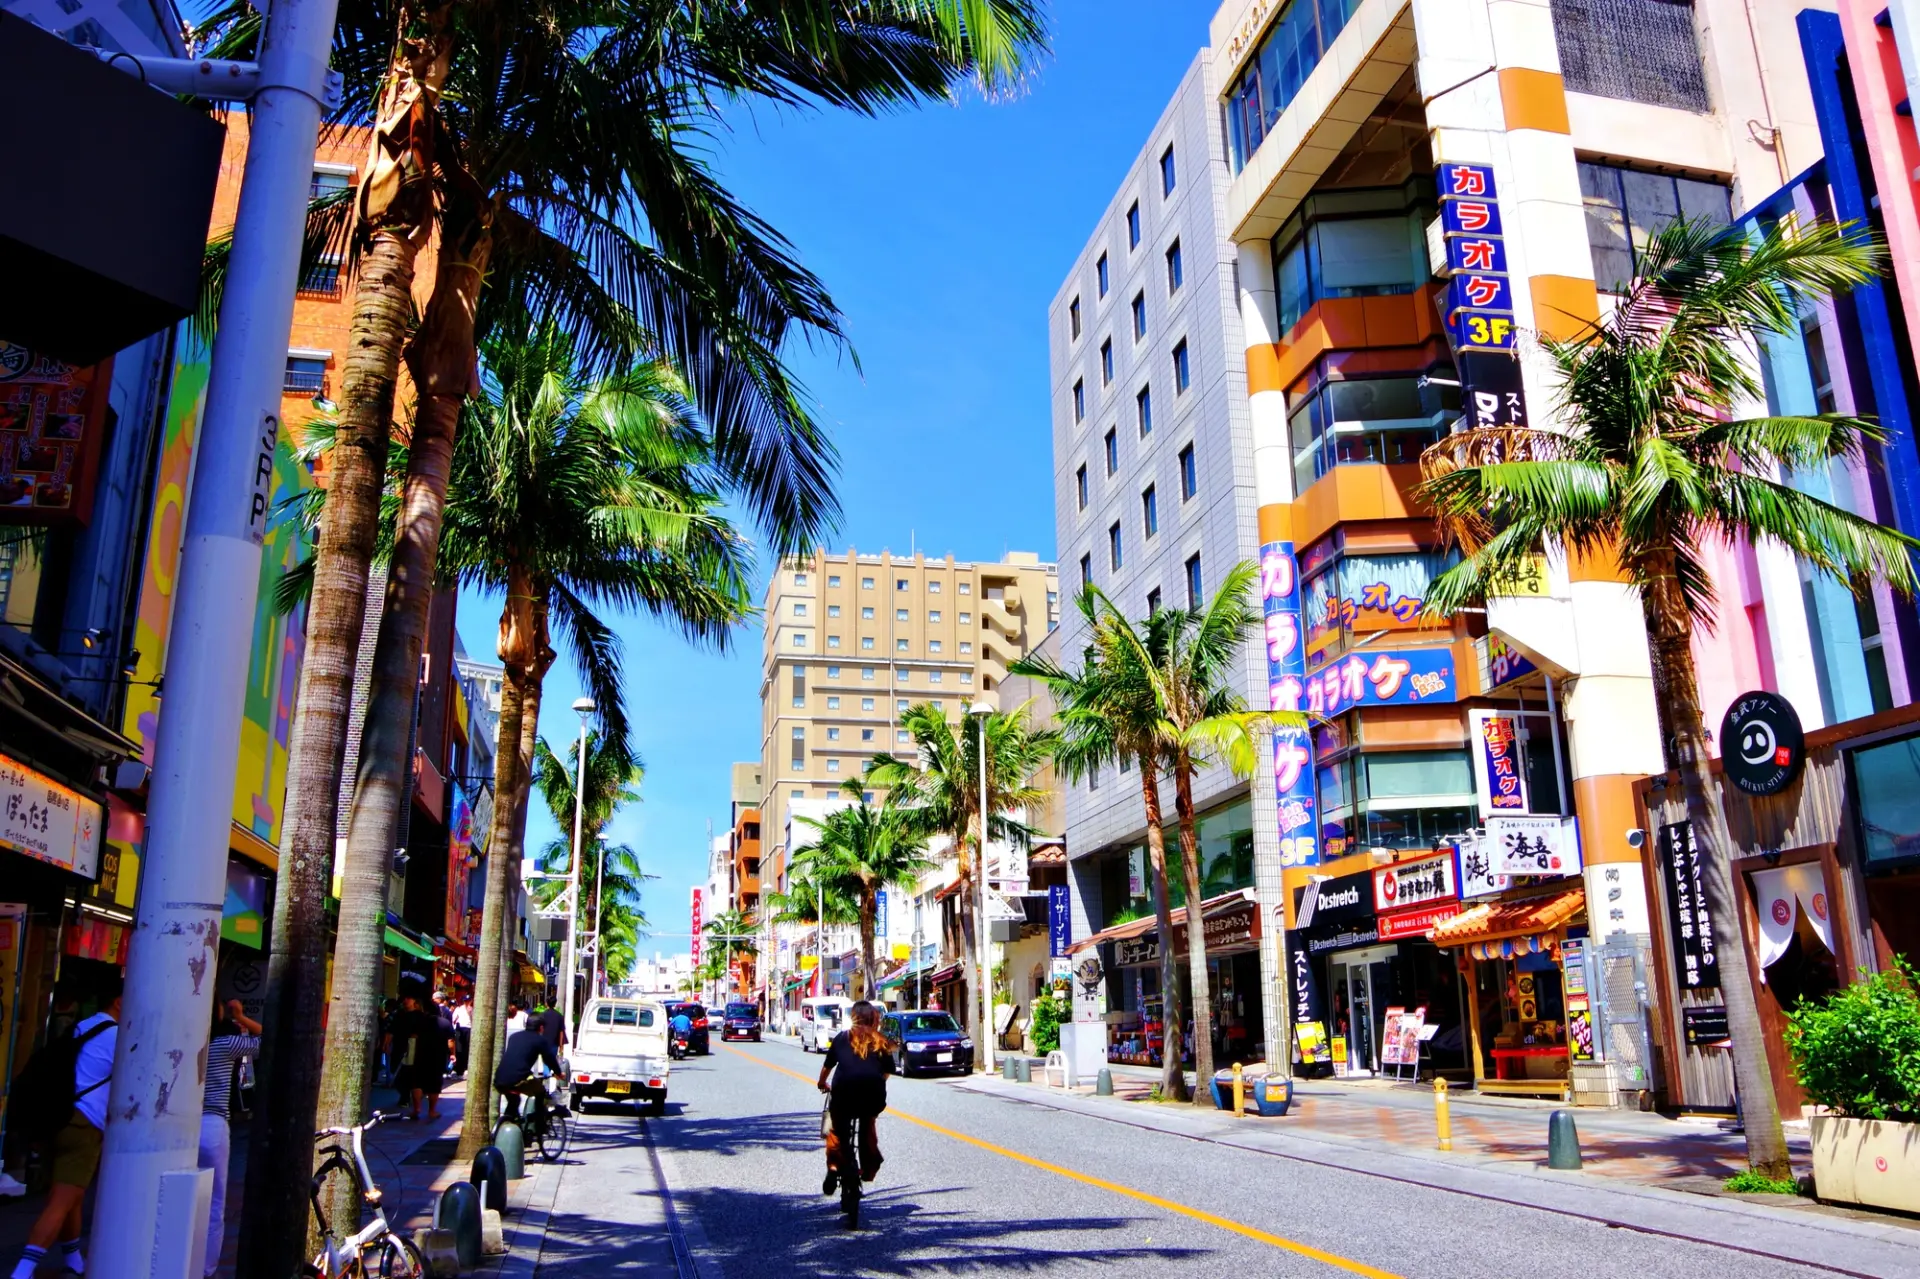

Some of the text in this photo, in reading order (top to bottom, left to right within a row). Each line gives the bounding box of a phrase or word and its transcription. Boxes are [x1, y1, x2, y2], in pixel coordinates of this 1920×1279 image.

[1452, 166, 1501, 306] カラオケ
[1469, 316, 1510, 345] 3F
[1326, 581, 1423, 625] カラオケ
[1262, 553, 1308, 793] カラオケ
[1306, 655, 1411, 715] カラオケ
[1485, 722, 1518, 795] カラオケ
[1767, 768, 1785, 788] STYLE
[104, 853, 118, 874] COS
[1280, 838, 1316, 867] 3F
[101, 873, 116, 892] MIC
[1318, 885, 1359, 911] Dr.stretch
[1313, 936, 1338, 950] Dr.stretch
[1353, 930, 1379, 943] Dr.stretch
